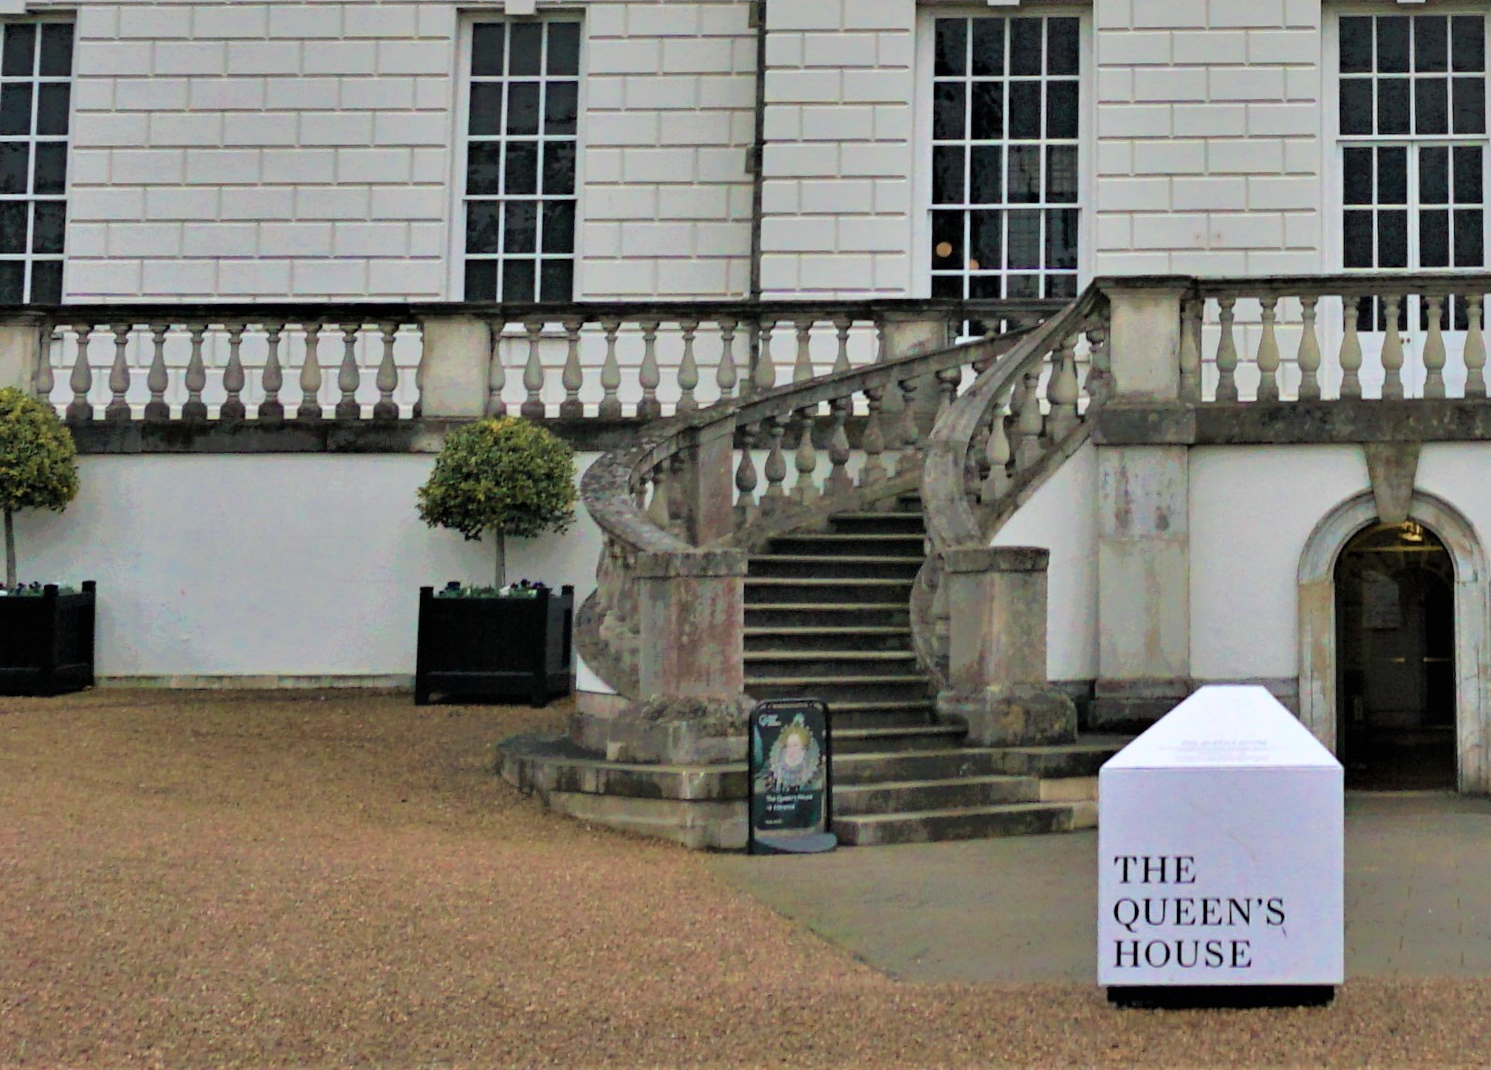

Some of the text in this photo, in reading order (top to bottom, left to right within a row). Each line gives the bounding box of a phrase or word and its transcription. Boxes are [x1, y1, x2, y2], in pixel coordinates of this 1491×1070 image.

[1113, 855, 1197, 884] THE
[1113, 897, 1286, 933] QUEEN'S
[1113, 939, 1253, 968] HOUSE
